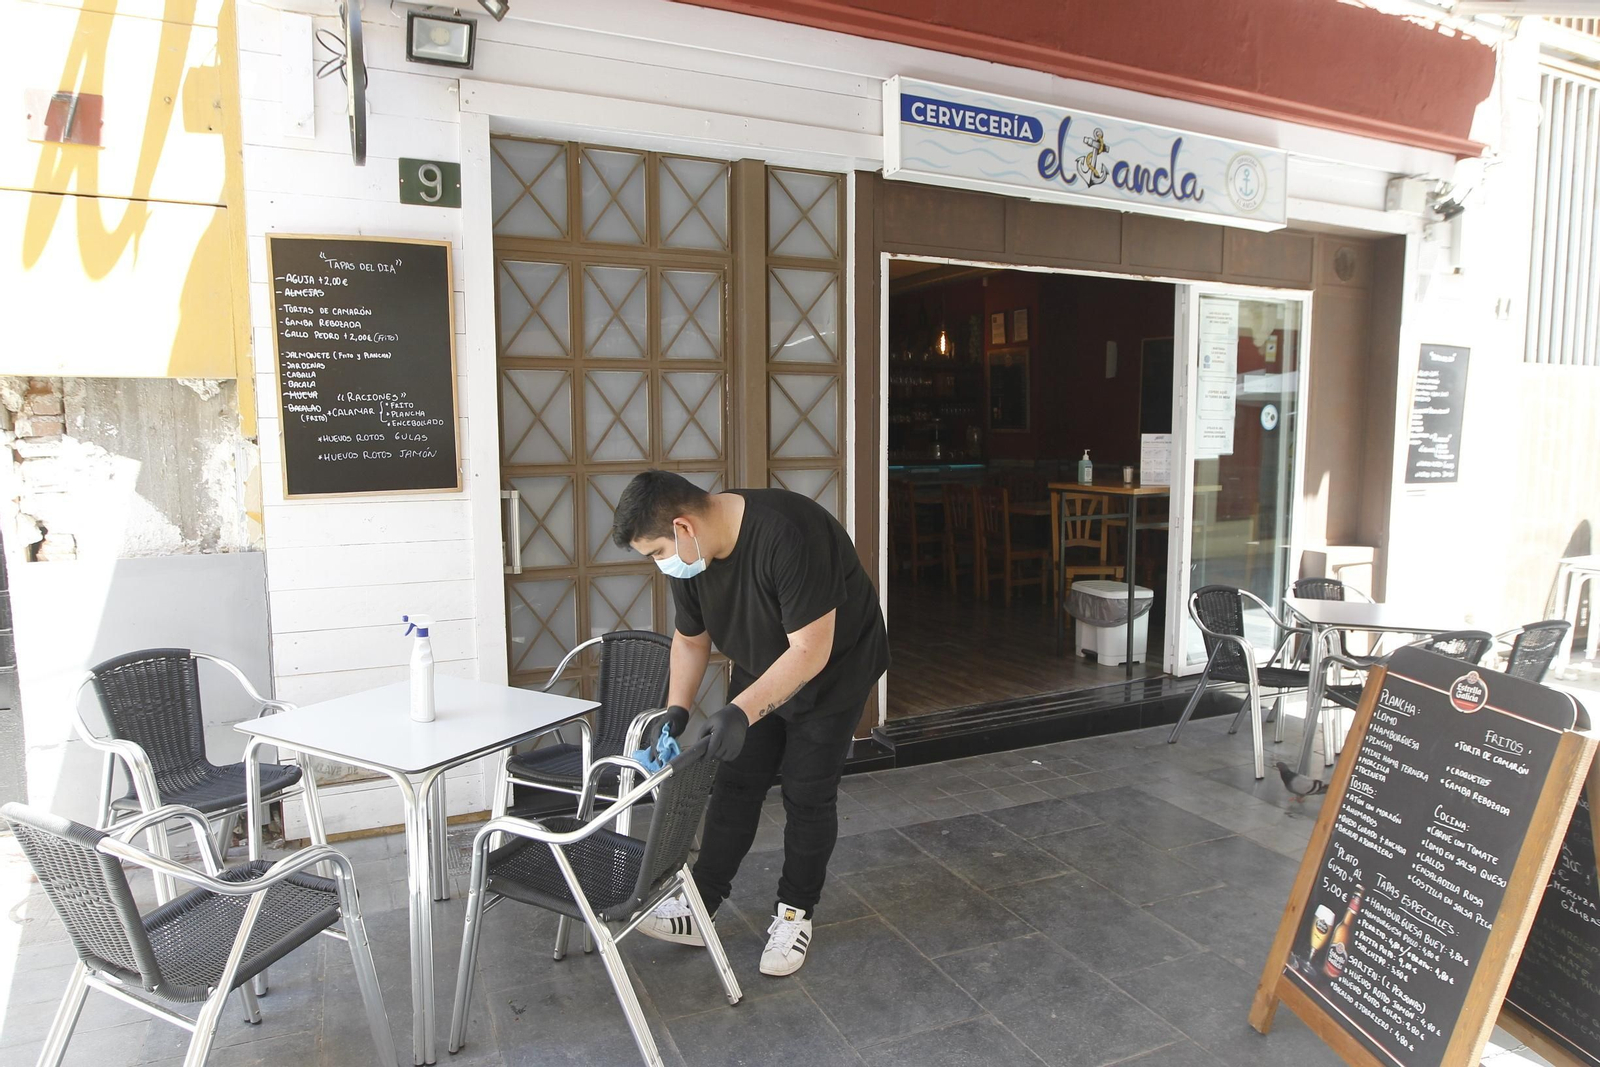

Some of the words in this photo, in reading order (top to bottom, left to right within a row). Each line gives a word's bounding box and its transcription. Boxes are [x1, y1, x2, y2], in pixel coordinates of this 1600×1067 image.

[911, 101, 1034, 141] CERVECERÍA
[1037, 115, 1077, 185] el
[1111, 137, 1205, 203] ancla
[418, 163, 443, 203] 9
[359, 263, 375, 272] DEL
[286, 273, 315, 285] AGUJA
[283, 304, 314, 314] TORTAS
[285, 318, 313, 327] GAMBA
[319, 318, 362, 329] REBOZADA
[284, 330, 309, 339] GALLO
[314, 332, 340, 340] PEDRO
[391, 410, 425, 418] PLANCHA
[356, 433, 385, 441] ROTOS
[363, 450, 392, 460] ROTOS
[1456, 682, 1482, 695] Estrella
[1455, 690, 1479, 703] Galicia
[1376, 710, 1397, 726] LOMO
[1368, 735, 1393, 752] PINCHO
[1459, 740, 1481, 756] TORTA
[1482, 751, 1492, 761] DE
[1444, 851, 1455, 861] EN
[1467, 843, 1499, 866] TOMATE
[1376, 872, 1400, 899] TAPAS
